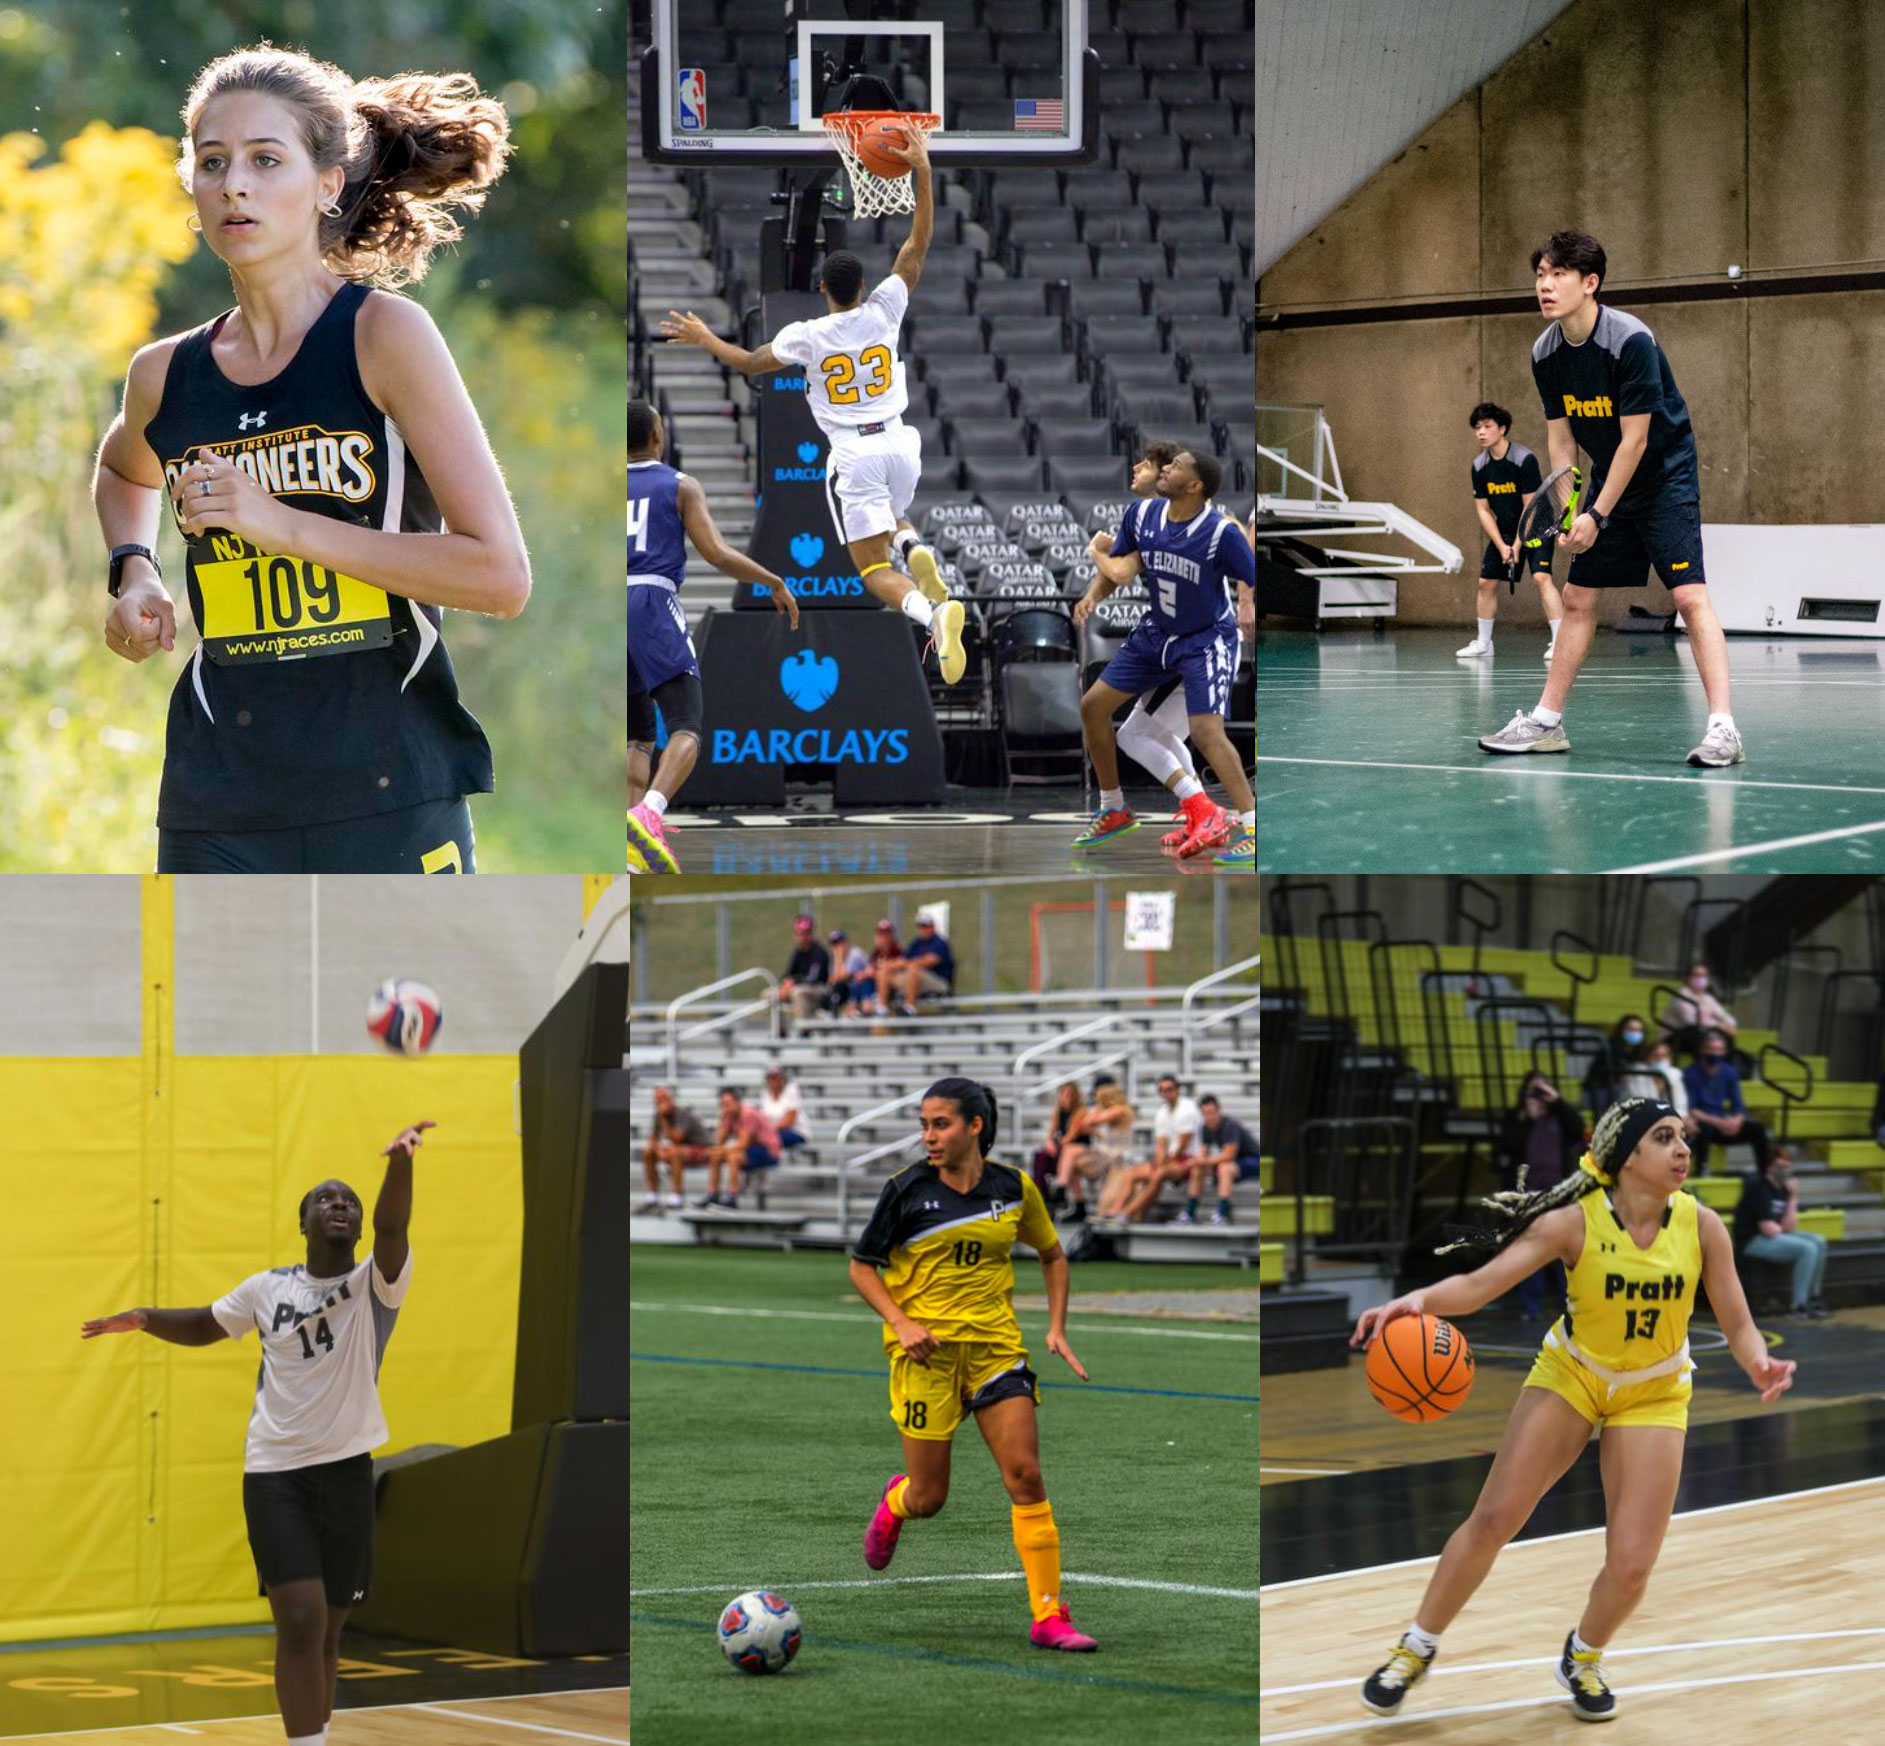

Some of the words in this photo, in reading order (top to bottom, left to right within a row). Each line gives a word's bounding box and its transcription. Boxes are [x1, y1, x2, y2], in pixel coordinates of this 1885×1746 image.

[671, 138, 713, 149] SPALDING
[820, 344, 892, 405] 23
[1562, 394, 1613, 418] Pratt
[242, 429, 309, 450] INSTITUTE
[774, 468, 827, 481] BARCLA
[1487, 481, 1516, 495] Pratt
[930, 505, 983, 521] QATAR
[1011, 504, 1063, 520] QATAR
[943, 524, 996, 540] QATAR
[1026, 522, 1079, 539] QATAR
[211, 534, 246, 561] NJ
[965, 544, 1018, 560] QATAR
[989, 563, 1043, 579] QATAR
[1153, 551, 1200, 585] ELIZABETH
[243, 556, 341, 632] 109
[1000, 585, 1055, 597] QATAR
[1157, 577, 1176, 618] 2
[226, 627, 365, 656] www.njraces.com
[712, 728, 910, 764] BARCLAYS
[953, 1240, 983, 1267] 18
[1605, 1272, 1685, 1301] Pratt
[297, 1316, 335, 1359] 14
[1624, 1308, 1661, 1342] 13
[903, 1399, 927, 1430] 18
